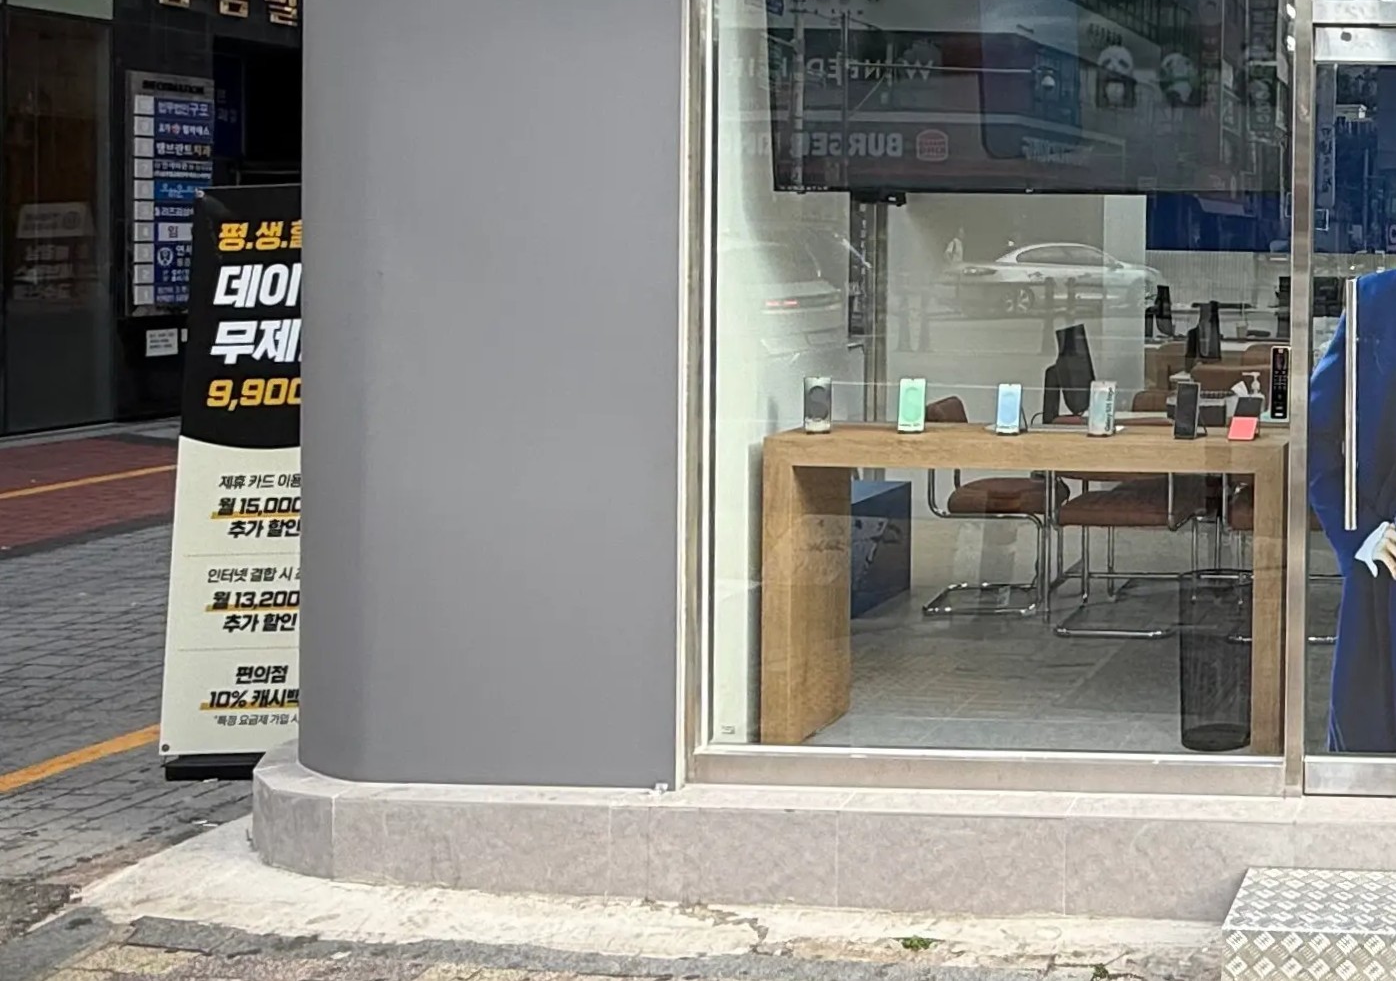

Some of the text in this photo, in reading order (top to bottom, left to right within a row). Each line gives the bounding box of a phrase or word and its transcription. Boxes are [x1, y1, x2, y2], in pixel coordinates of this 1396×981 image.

[218, 475, 246, 490] 제휴
[247, 474, 275, 489] 카드
[218, 497, 236, 516] 월
[228, 519, 264, 538] 추가
[207, 568, 248, 583] 인터넷
[250, 567, 276, 582] 결합
[278, 566, 293, 581] 시
[212, 590, 300, 610] 월 13,200
[223, 613, 298, 633] 추가 할인
[235, 665, 288, 685] 편의점
[209, 690, 248, 708] 10%
